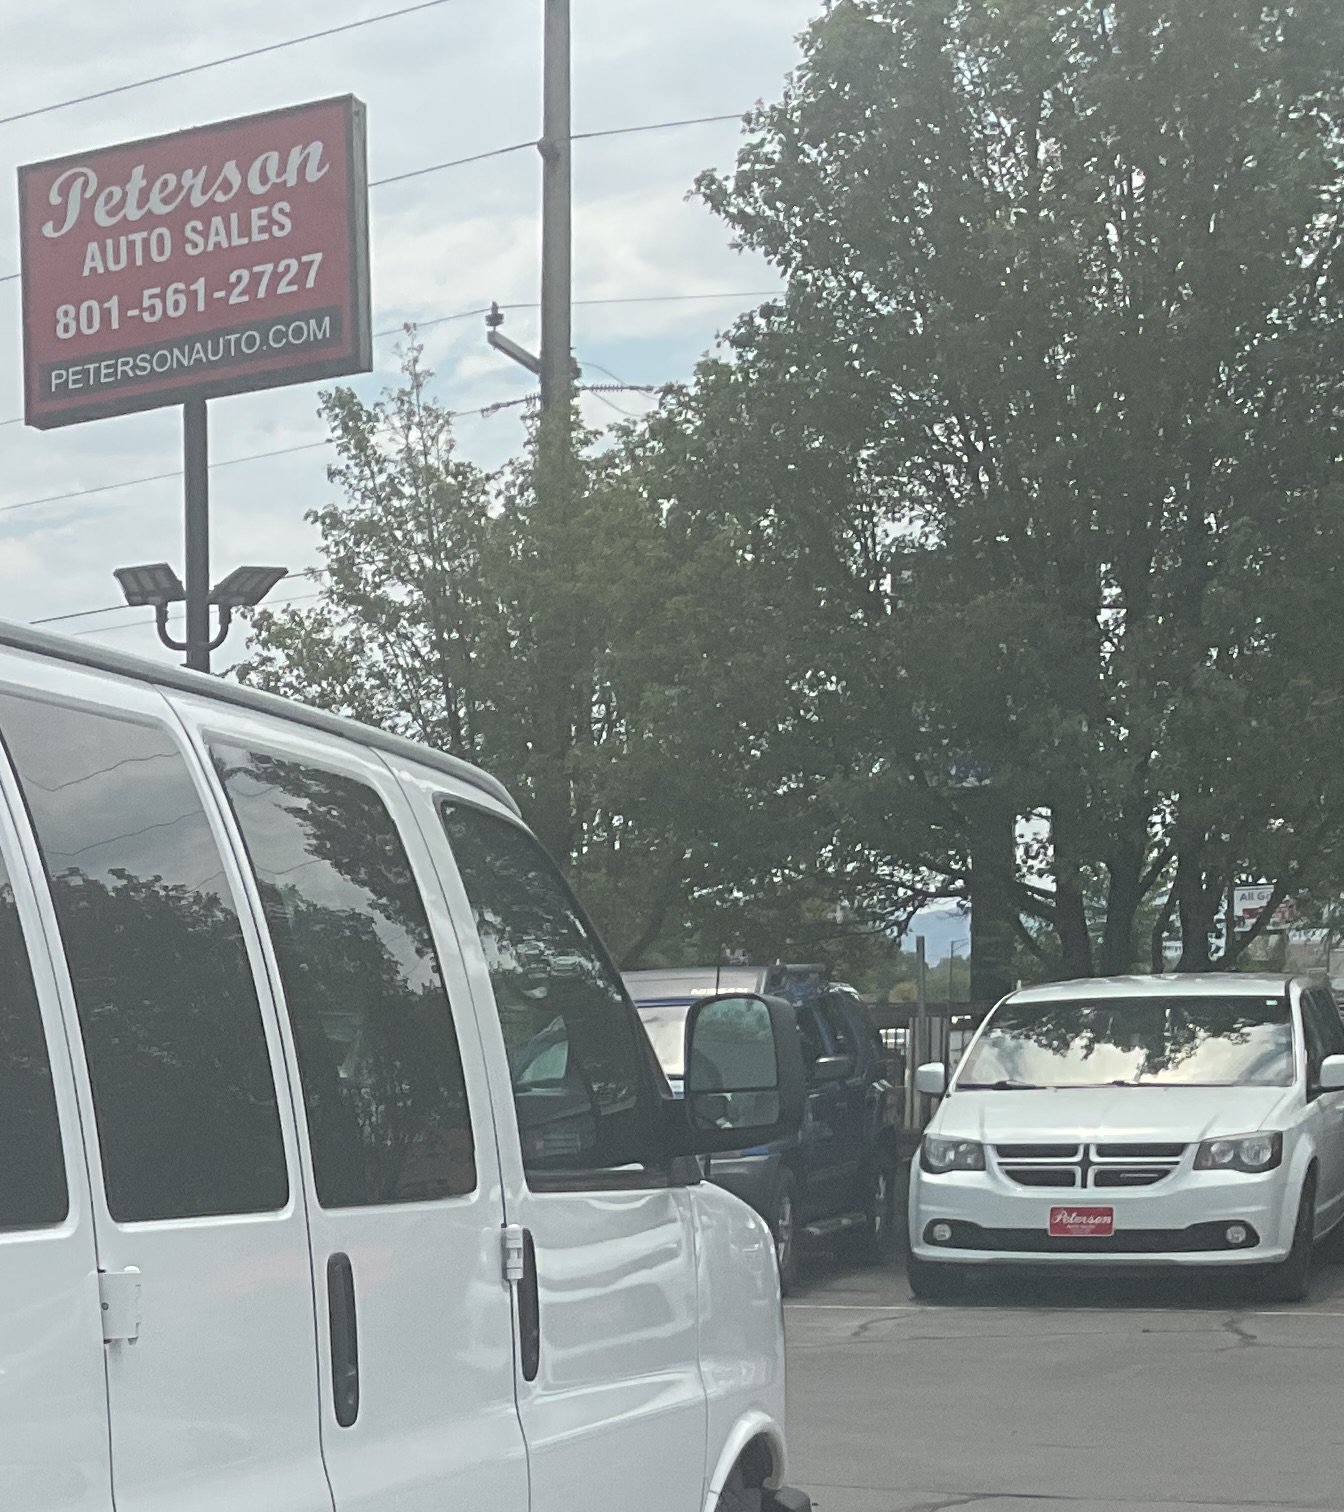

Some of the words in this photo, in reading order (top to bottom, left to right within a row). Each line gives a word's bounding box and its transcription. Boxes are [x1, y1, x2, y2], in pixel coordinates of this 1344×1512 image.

[42, 140, 330, 238] Peterson
[82, 227, 171, 277] AUTO
[184, 201, 292, 256] SALES
[55, 252, 323, 339] 801-561-2727
[50, 316, 331, 392] PETERSONAUTO.COM
[1053, 1209, 1112, 1224] Peterson
